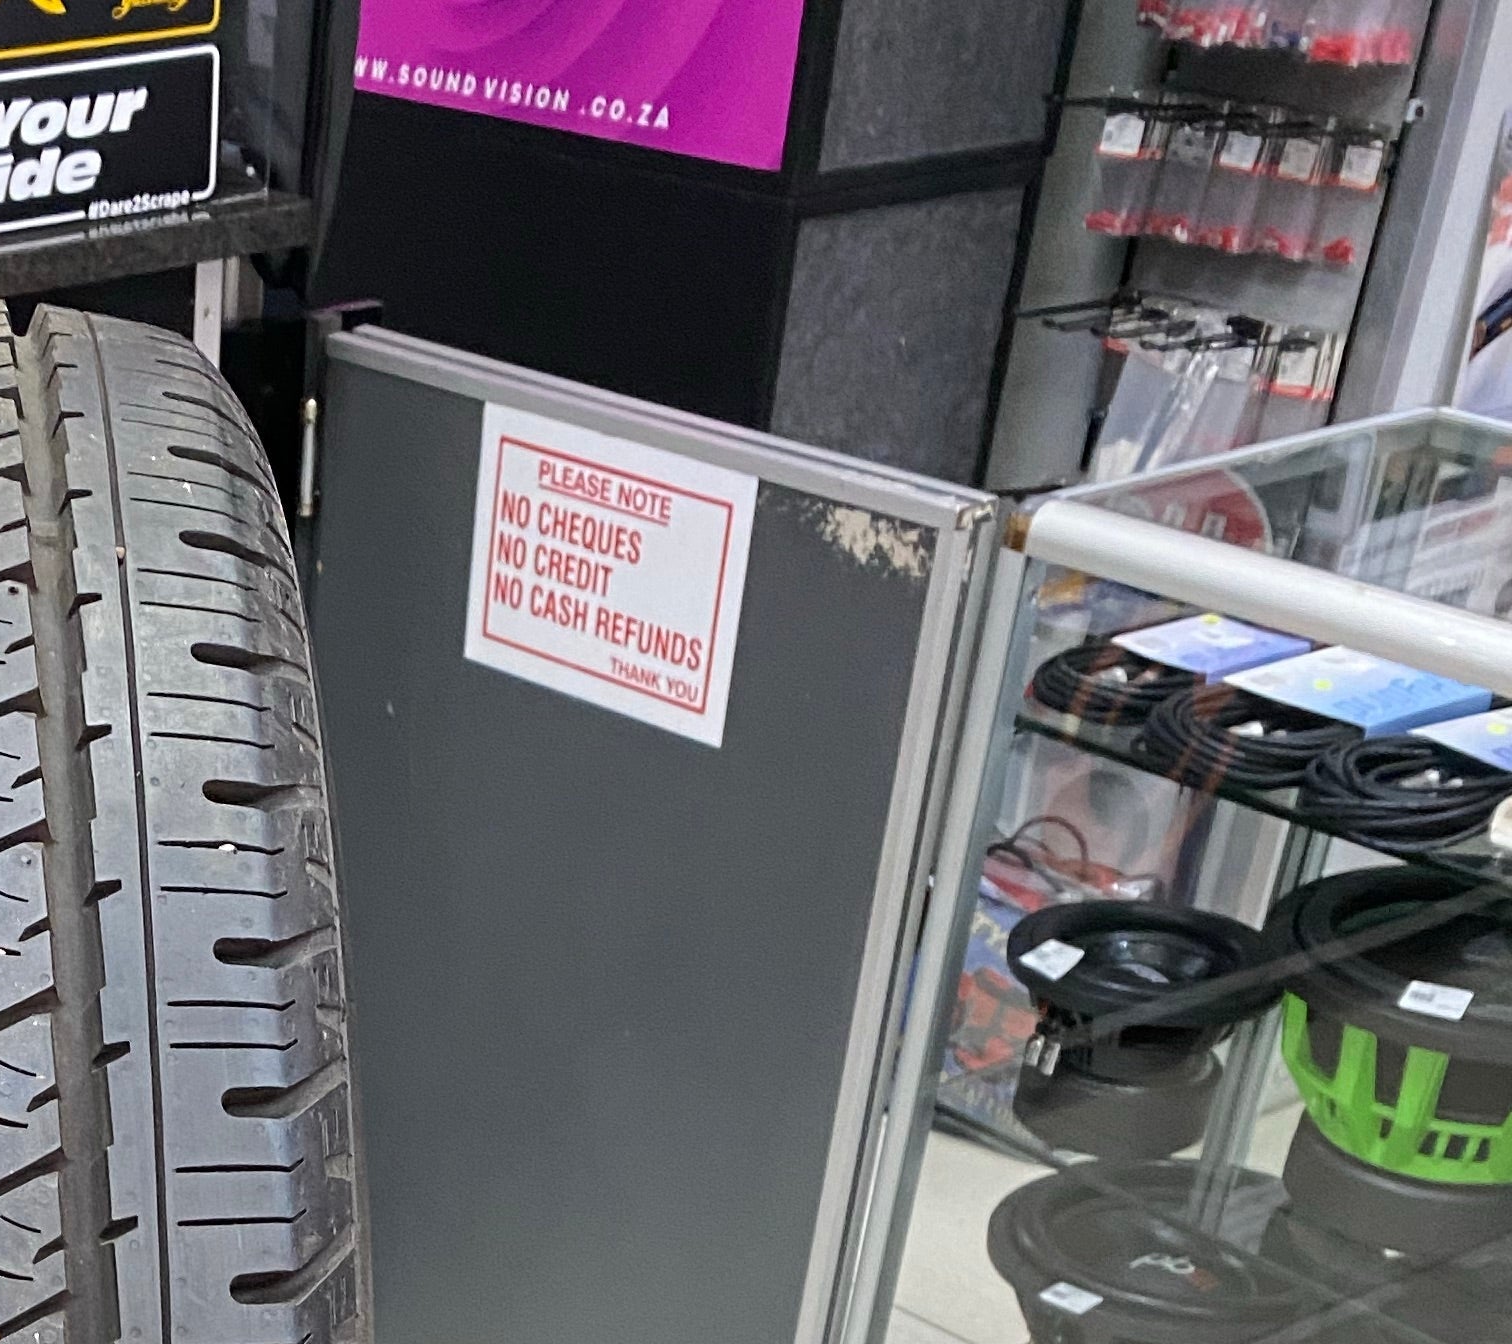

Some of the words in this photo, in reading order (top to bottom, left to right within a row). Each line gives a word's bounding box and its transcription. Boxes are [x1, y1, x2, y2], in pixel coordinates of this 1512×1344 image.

[88, 189, 190, 220] #Dare2Scrape
[538, 459, 611, 502] PLEASE
[618, 484, 672, 521] NOTE
[501, 489, 531, 529] NO
[538, 502, 643, 565] CHEQUES
[498, 530, 527, 570] NO
[534, 544, 613, 597] CREDIT
[494, 572, 523, 610] NO
[530, 585, 588, 634] CASH
[595, 607, 703, 672] REFUNDS
[610, 656, 660, 691] THANK
[666, 678, 699, 702] YOU
